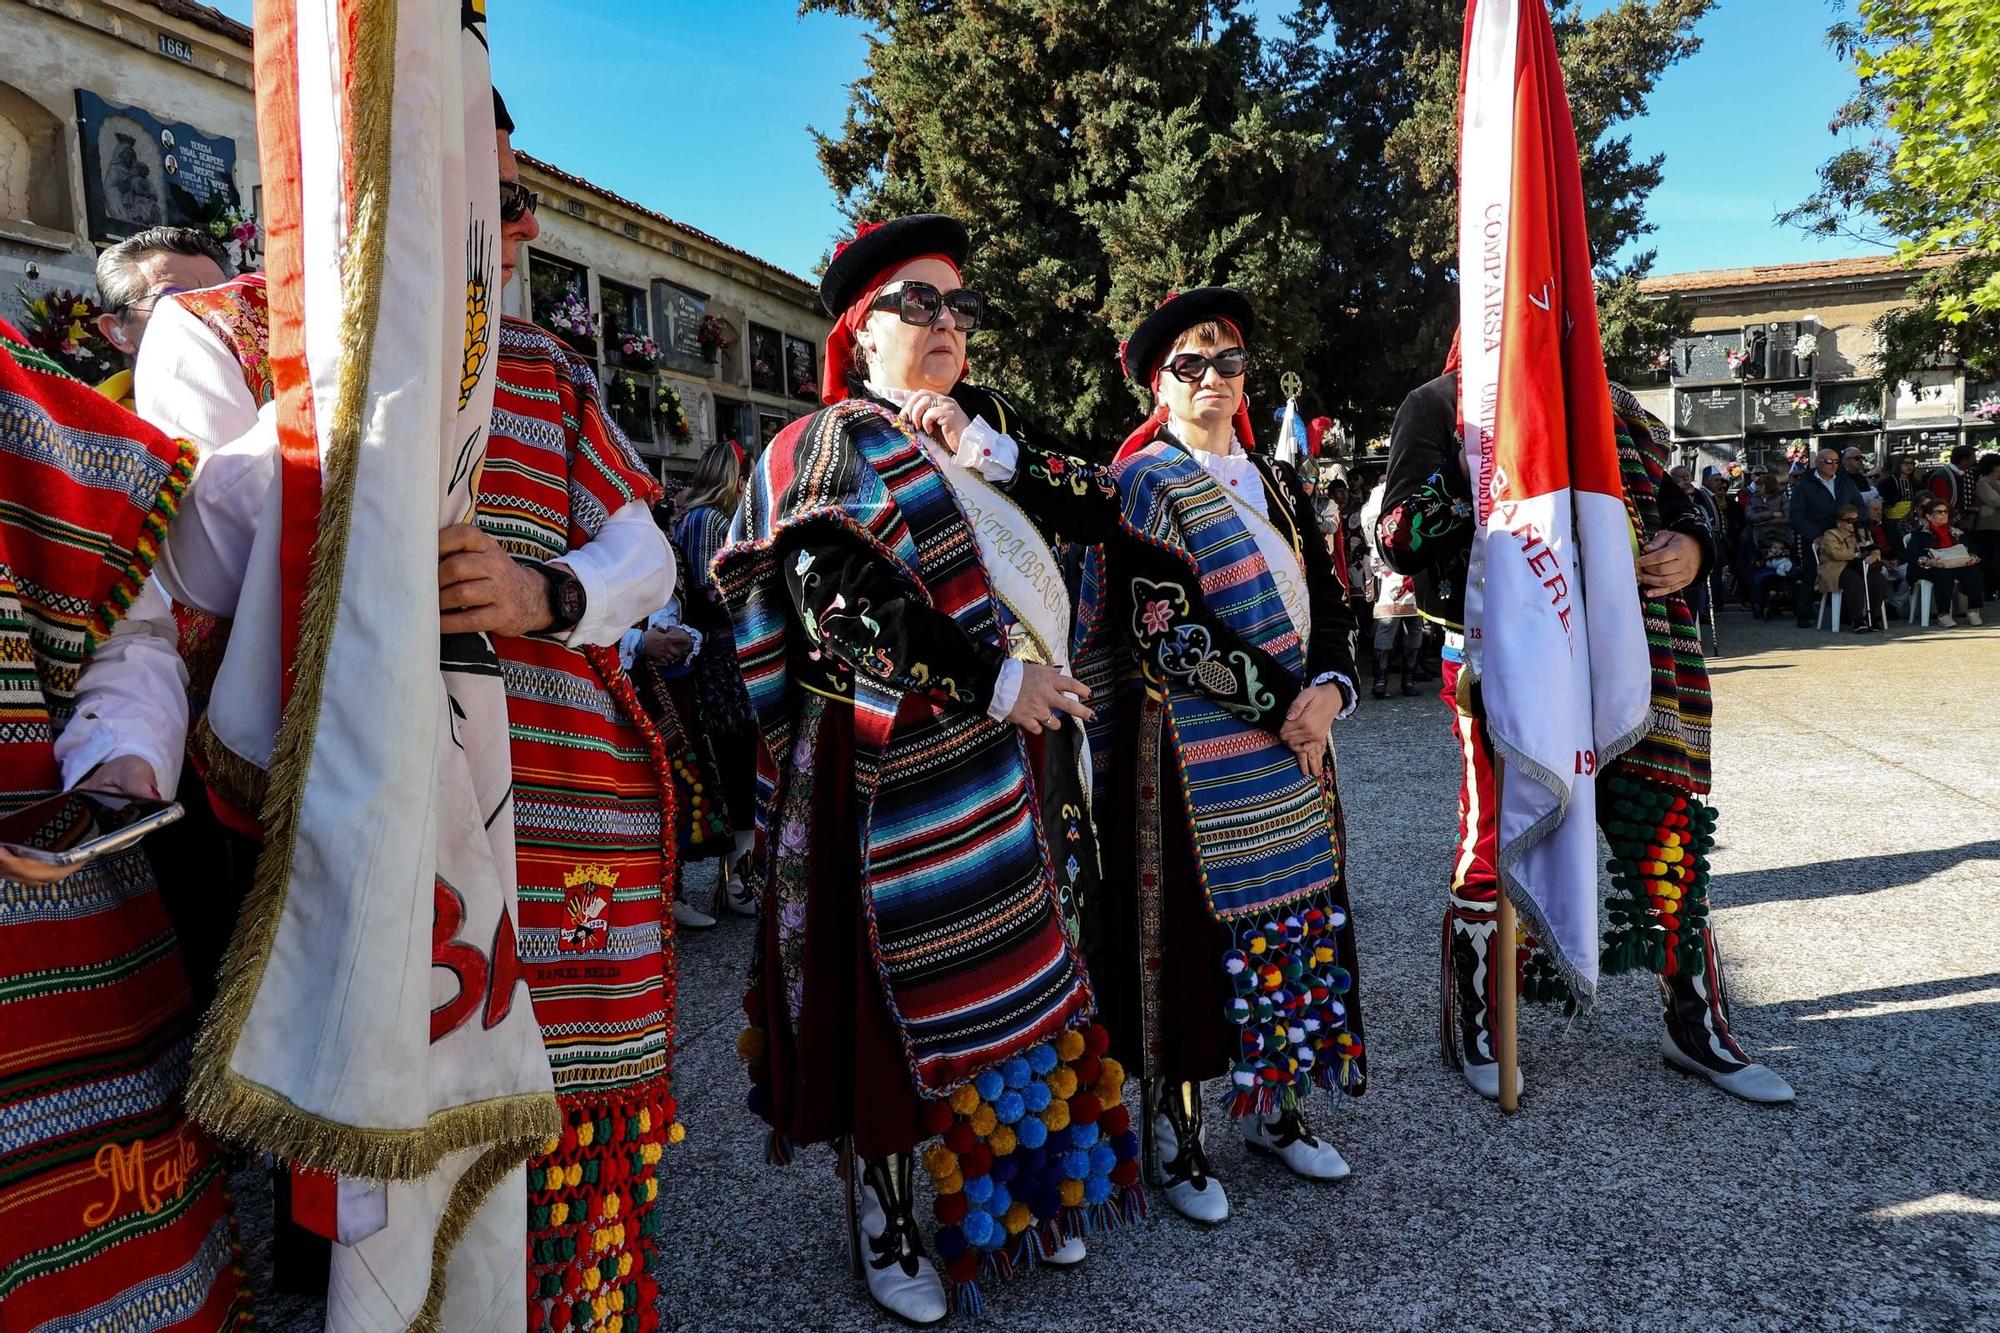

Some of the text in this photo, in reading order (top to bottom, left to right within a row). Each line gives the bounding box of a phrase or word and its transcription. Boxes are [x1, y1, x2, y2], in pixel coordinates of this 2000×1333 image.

[160, 35, 191, 60] 1664
[1483, 203, 1503, 354] COMPARSA
[537, 966, 620, 979] RAFAEL BELDA
